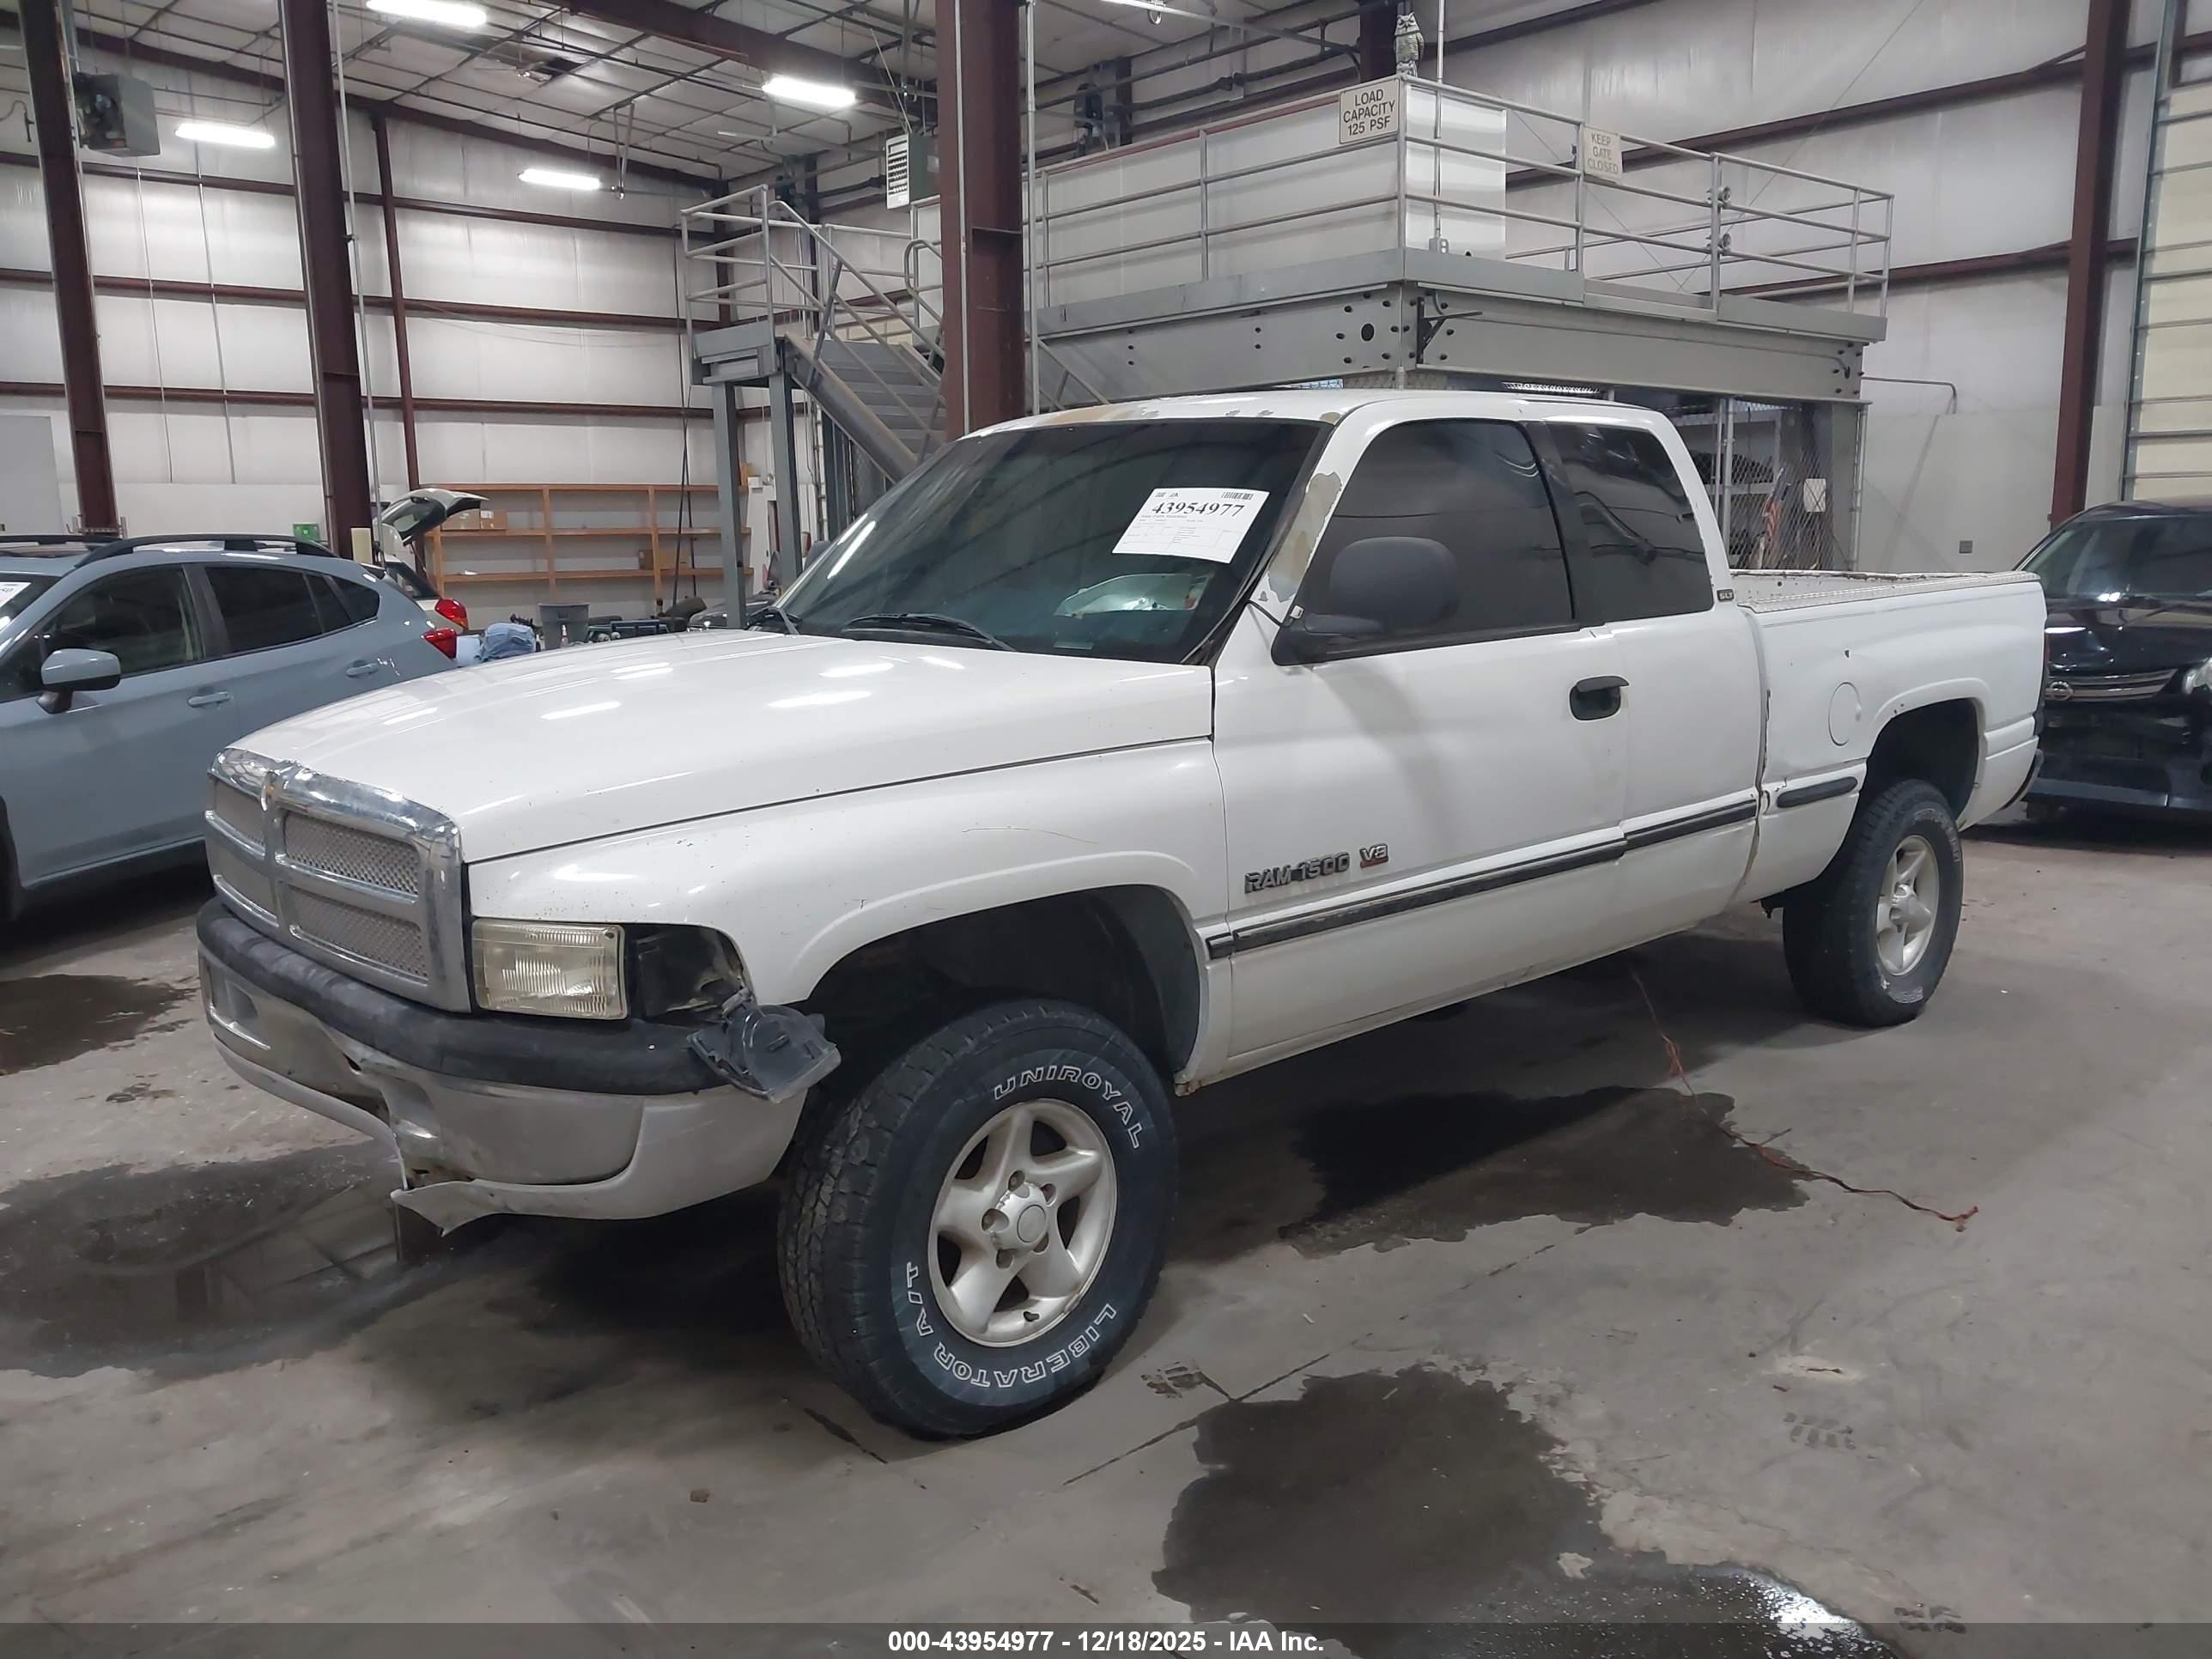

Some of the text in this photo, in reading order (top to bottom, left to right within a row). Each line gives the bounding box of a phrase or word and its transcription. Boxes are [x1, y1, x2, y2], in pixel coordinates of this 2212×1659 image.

[1354, 89, 1384, 106] LOAD
[1343, 100, 1395, 123] CAPACITY
[1347, 115, 1391, 137] 125 PSF
[1591, 132, 1611, 145] KEEP
[1593, 146, 1613, 161] GATE
[1588, 157, 1619, 174] CLOSED
[1152, 501, 1245, 516] 43954977
[1360, 843, 1389, 868] V8
[1245, 852, 1350, 893] RAM 1500
[994, 1065, 1146, 1149] UNIROYAL
[906, 1261, 1117, 1389] LIBERATOR A/T
